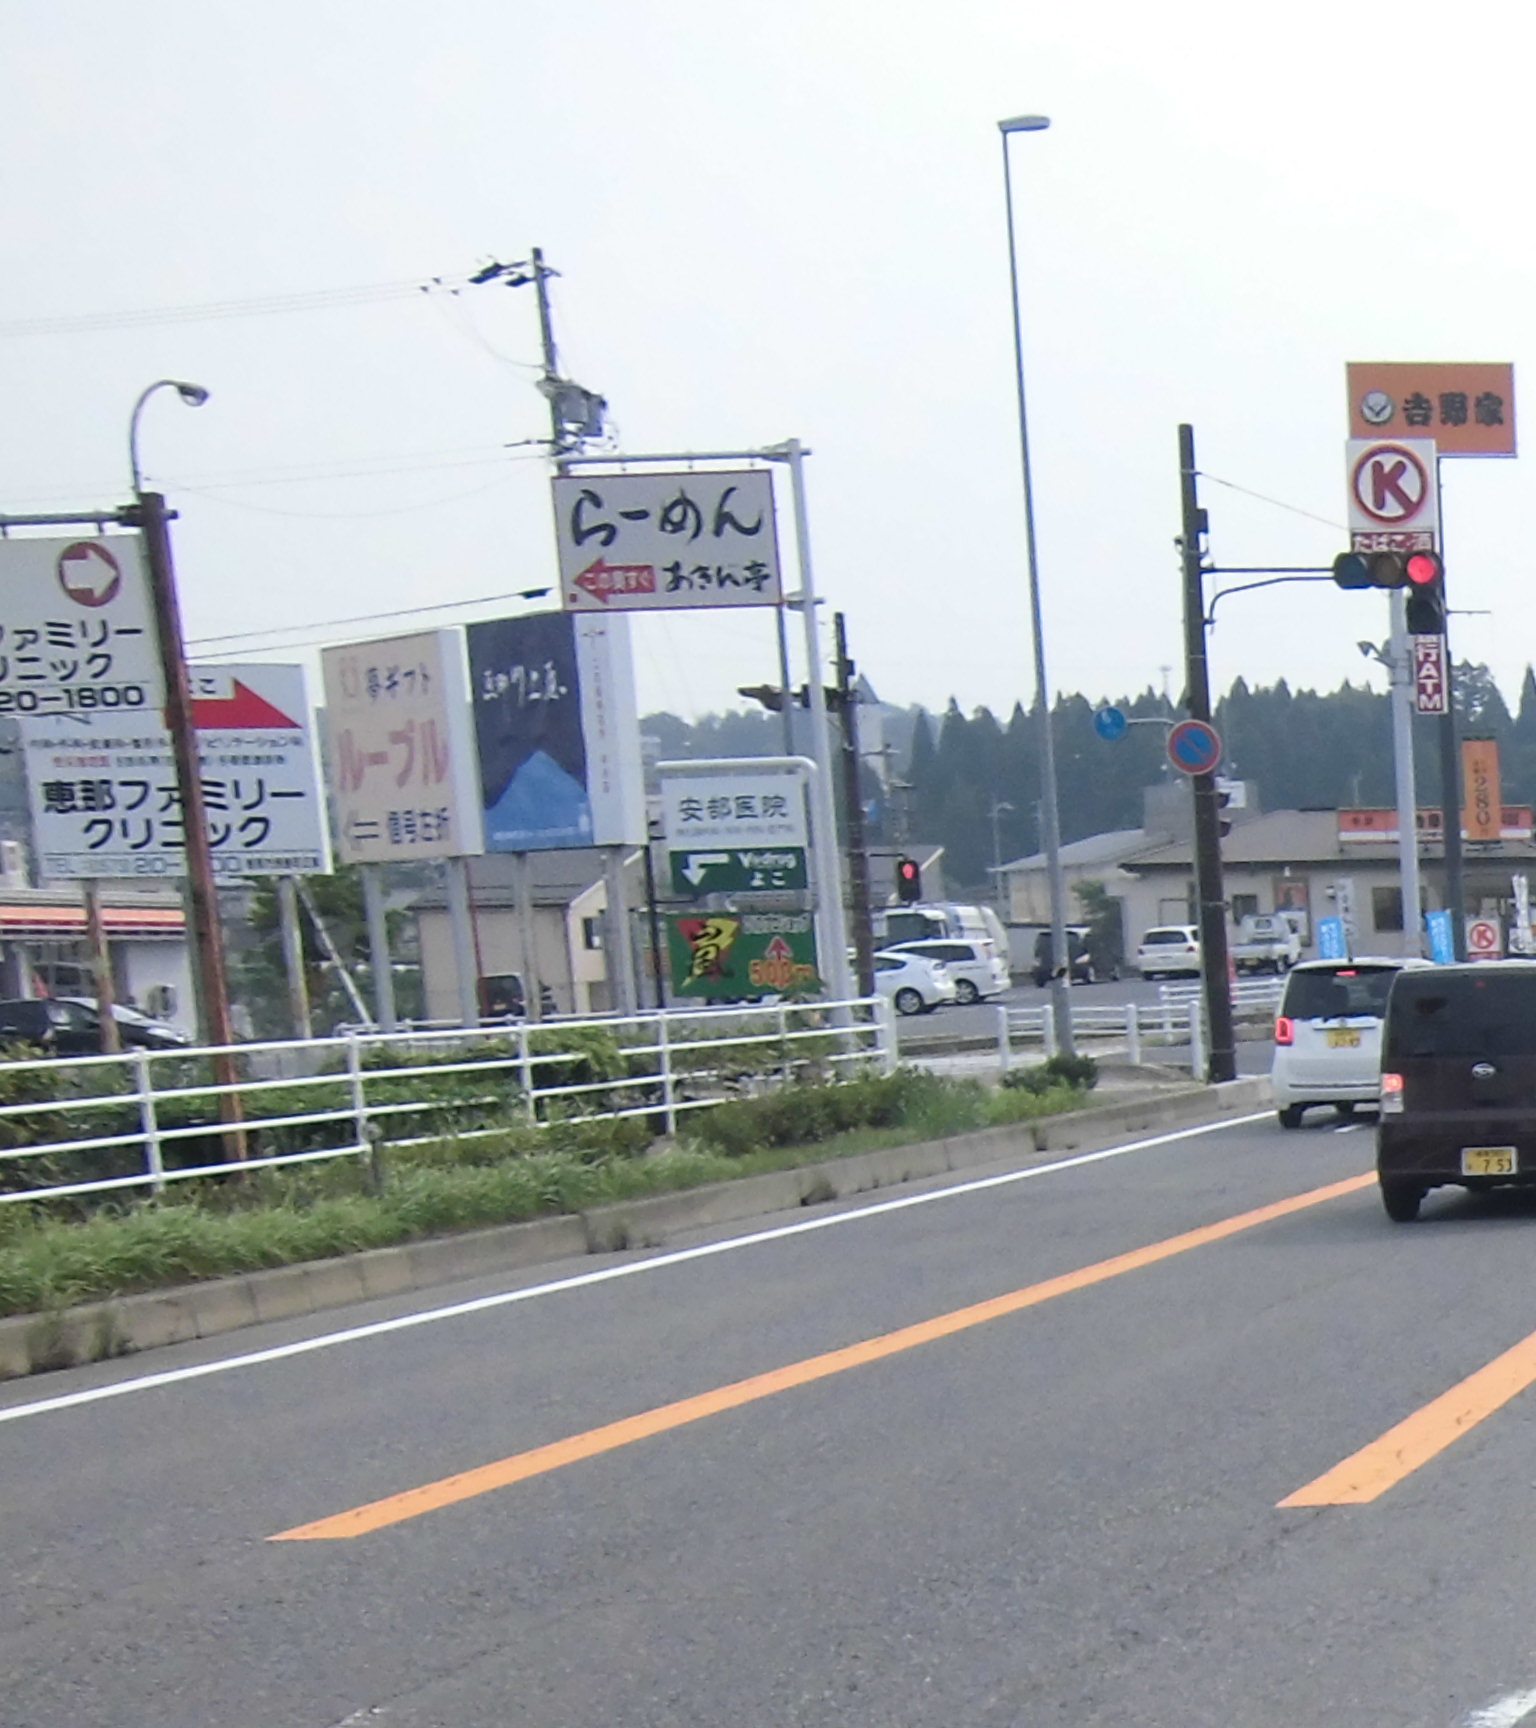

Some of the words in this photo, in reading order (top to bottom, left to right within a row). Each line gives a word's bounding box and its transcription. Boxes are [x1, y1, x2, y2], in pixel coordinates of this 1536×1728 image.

[570, 487, 764, 547] らーめん
[0, 619, 143, 651] ァミリー
